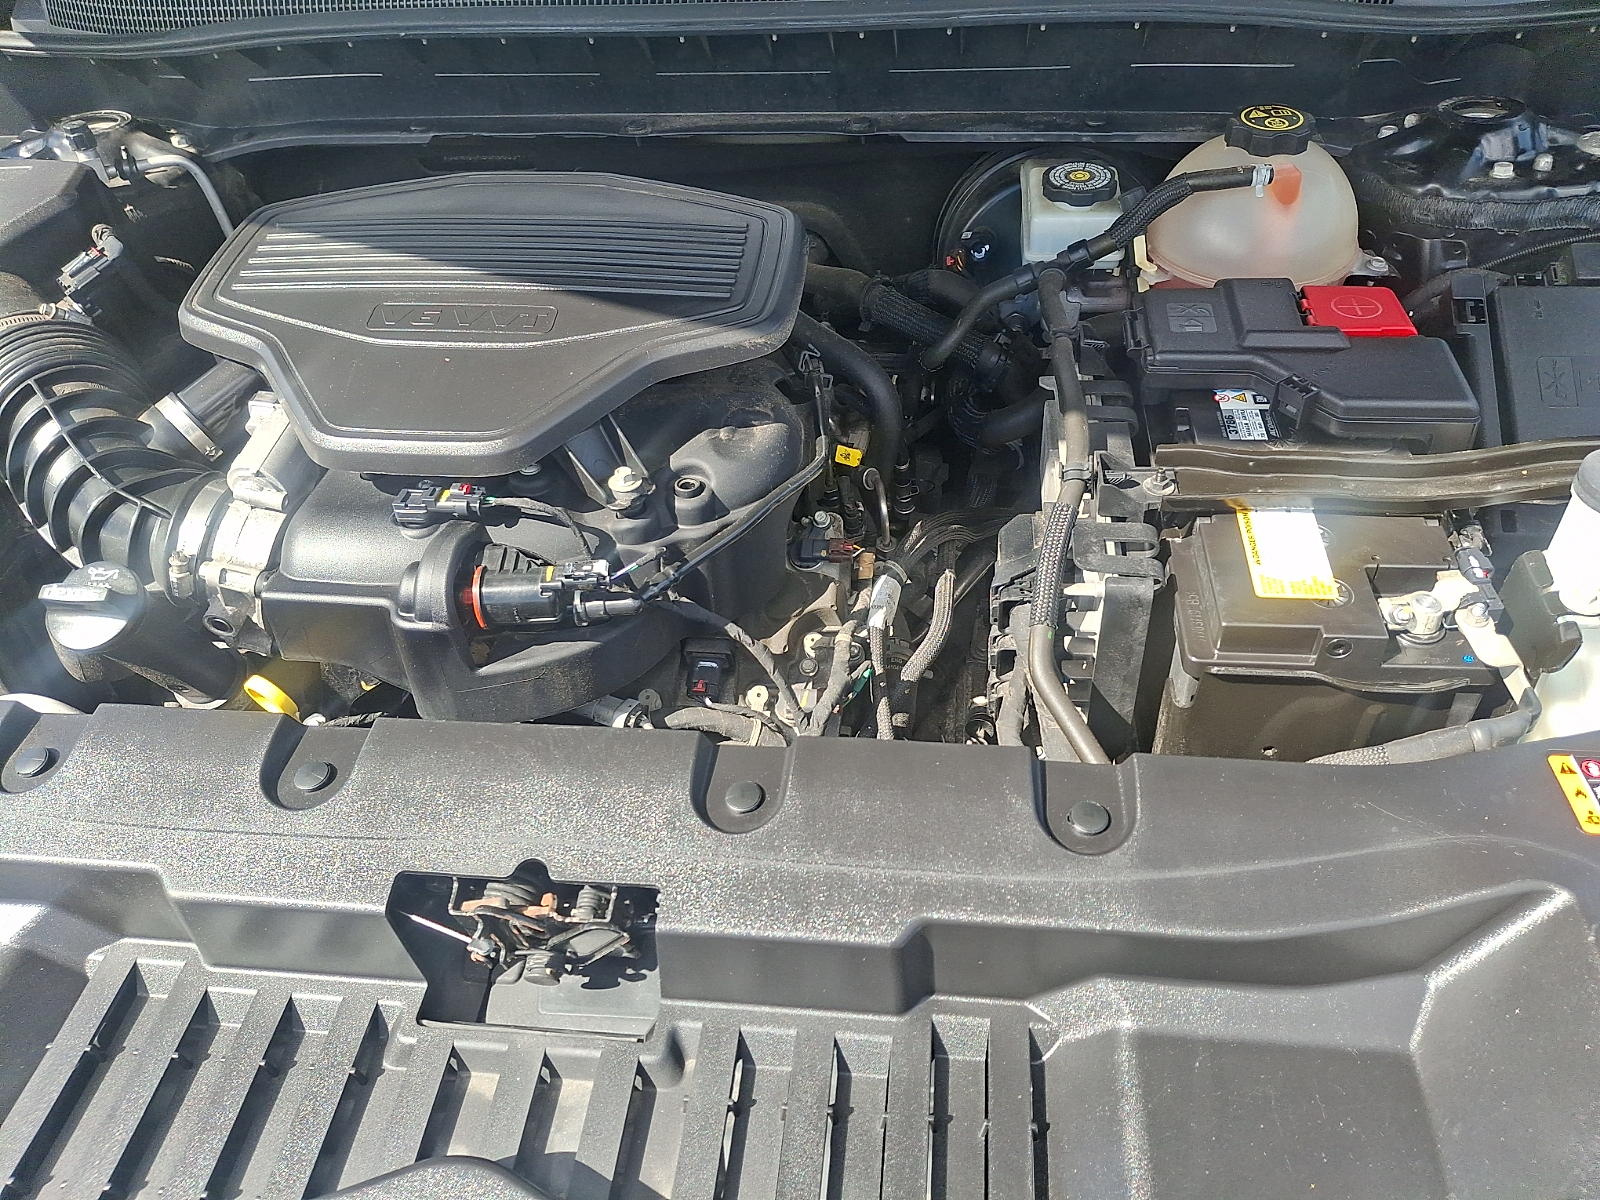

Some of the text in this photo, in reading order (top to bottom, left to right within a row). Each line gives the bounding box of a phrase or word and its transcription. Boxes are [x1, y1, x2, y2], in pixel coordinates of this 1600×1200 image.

[381, 308, 549, 328] V6 VVT
[1224, 414, 1239, 435] 3786
